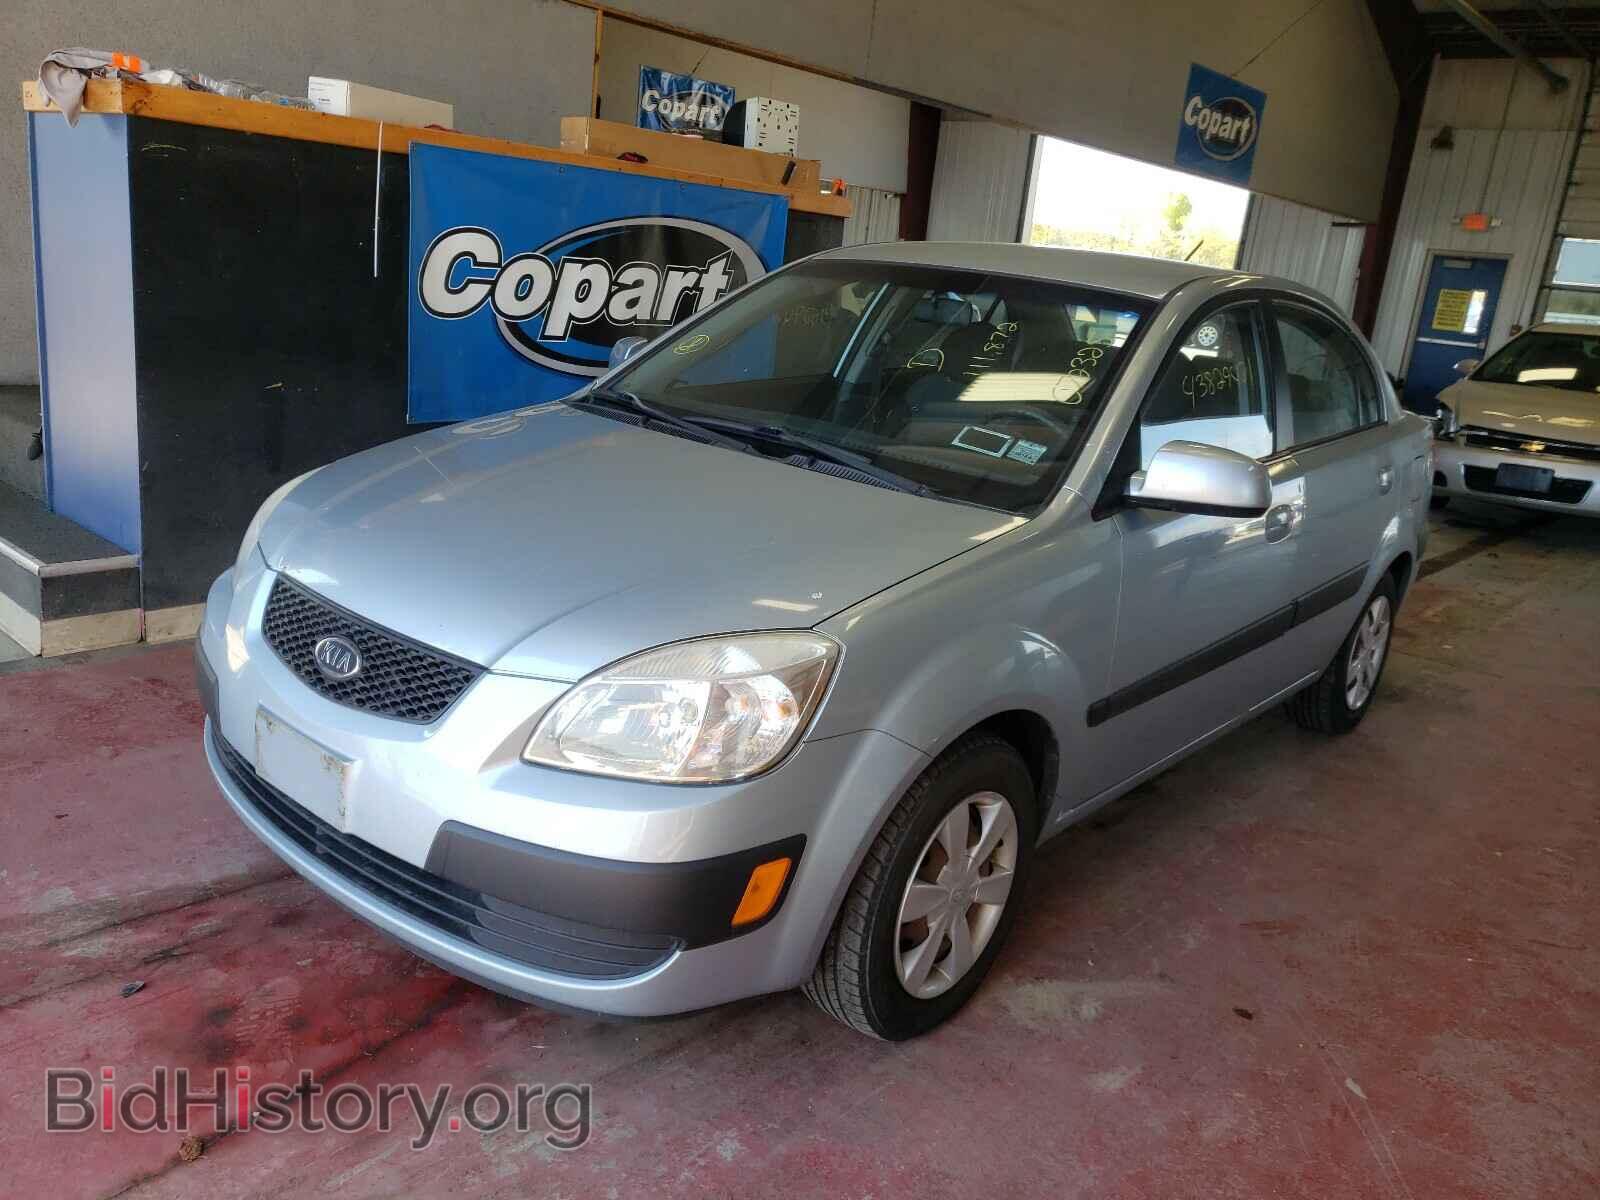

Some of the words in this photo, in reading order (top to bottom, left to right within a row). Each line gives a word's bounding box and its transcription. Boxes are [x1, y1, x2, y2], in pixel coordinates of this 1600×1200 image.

[641, 89, 723, 130] Copart
[1184, 95, 1252, 144] Copart
[418, 225, 735, 342] Copart
[320, 640, 352, 674] KIA
